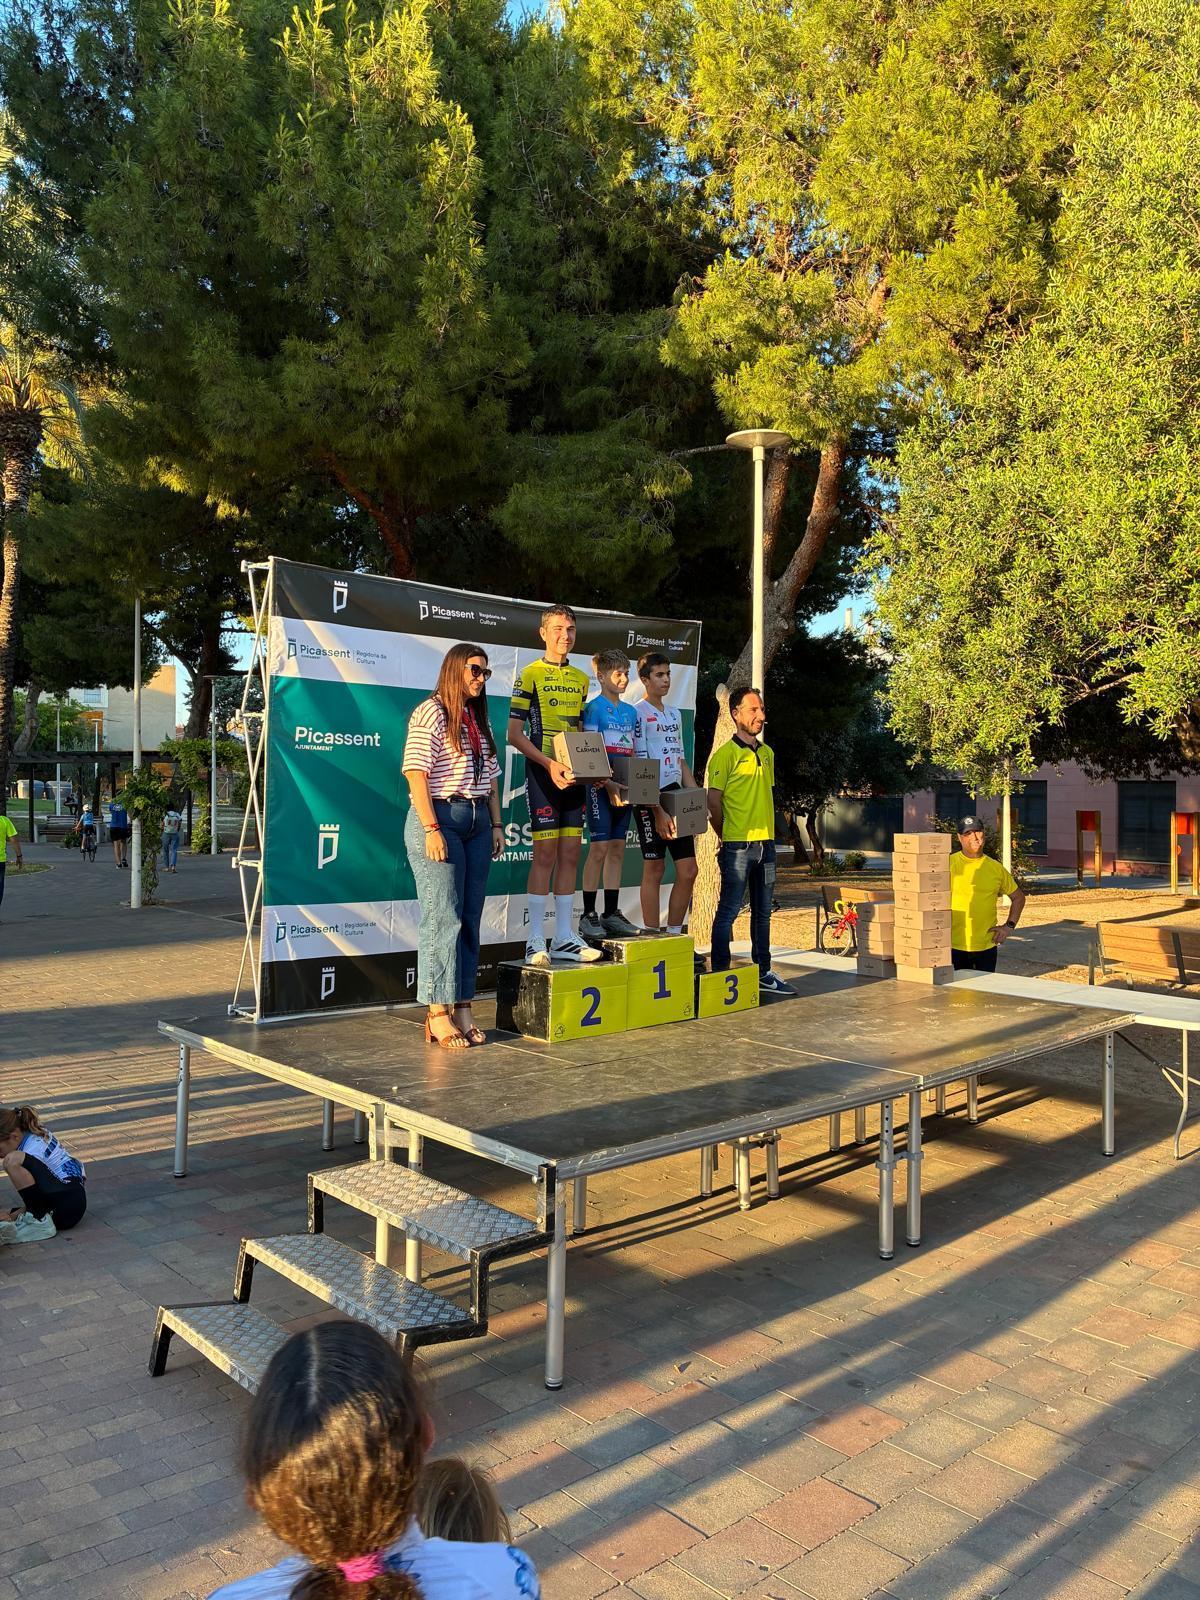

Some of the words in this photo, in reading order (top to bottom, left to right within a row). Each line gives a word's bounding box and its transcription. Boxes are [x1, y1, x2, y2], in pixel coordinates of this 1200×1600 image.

[431, 605, 475, 619] Picassent
[636, 634, 665, 646] Picassent
[300, 644, 350, 658] Picassent
[295, 726, 381, 747] Picassent
[640, 810, 653, 843] ALPESA
[290, 924, 340, 934] Picassent
[652, 960, 672, 999] 1
[724, 974, 739, 1005] 3
[580, 986, 602, 1027] 2
